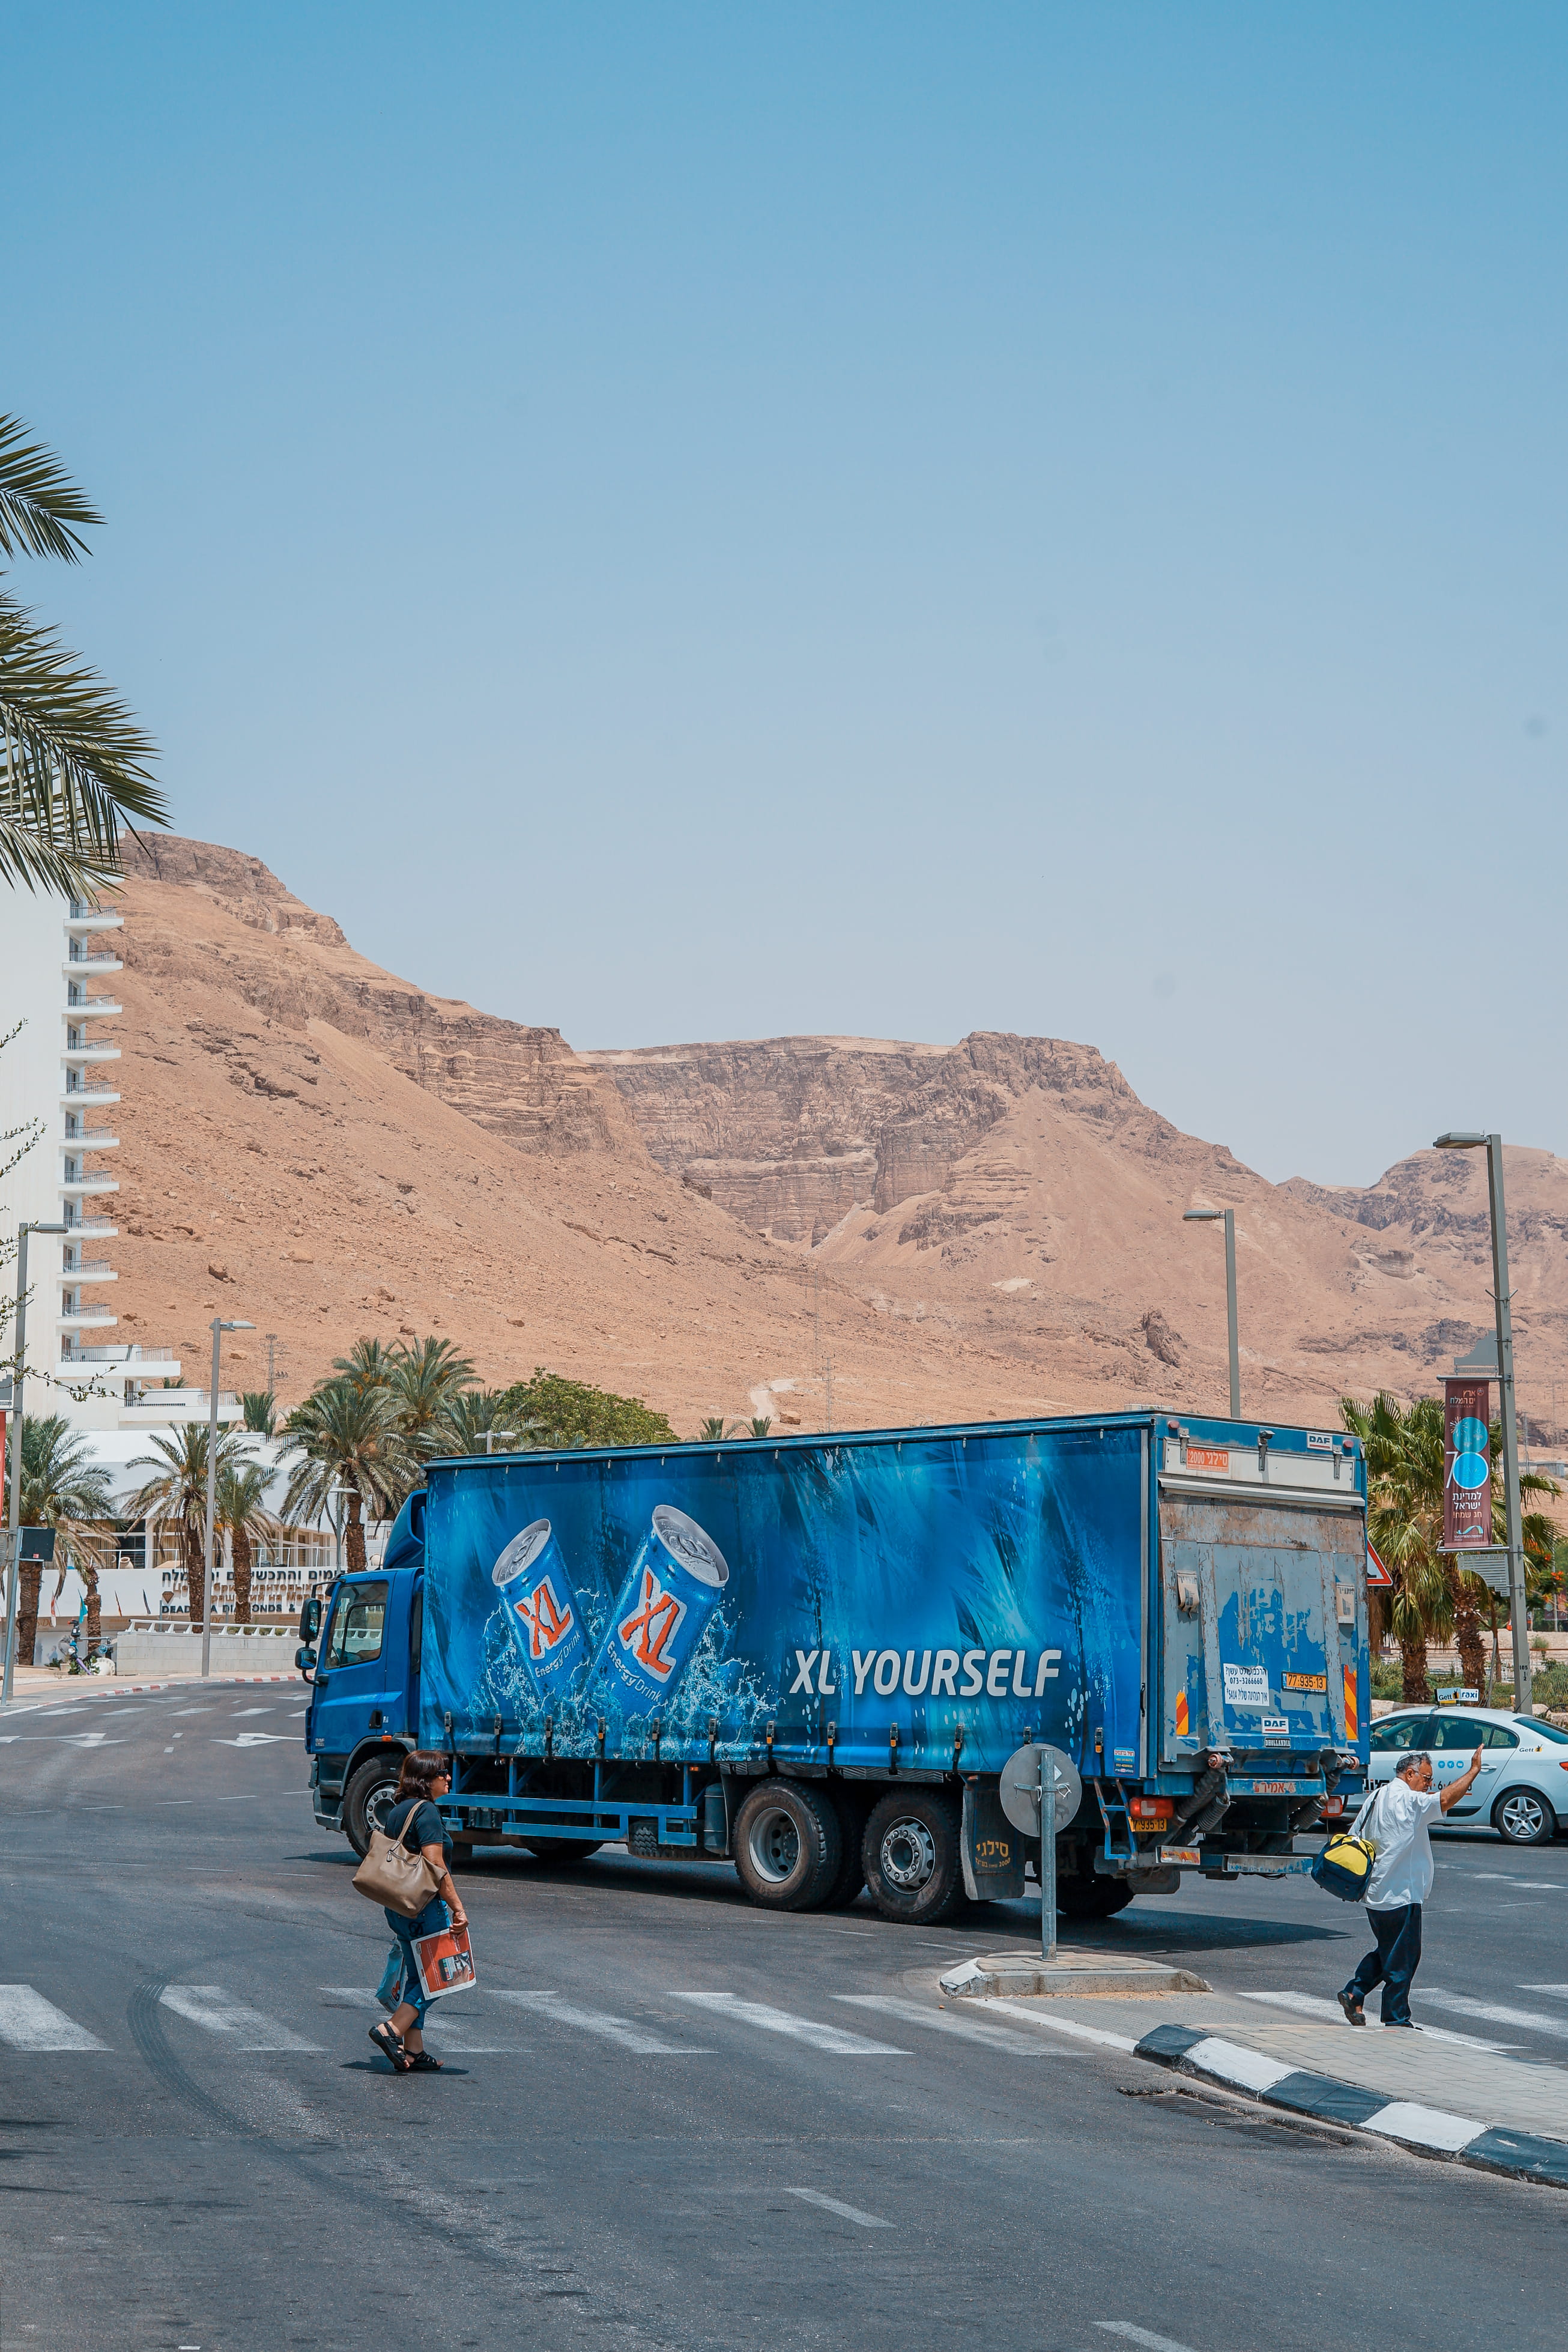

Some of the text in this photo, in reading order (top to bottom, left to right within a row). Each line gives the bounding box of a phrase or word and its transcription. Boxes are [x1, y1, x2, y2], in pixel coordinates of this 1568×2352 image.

[1309, 1435, 1330, 1444] DAF
[1190, 1450, 1205, 1464] 2000
[1206, 1451, 1227, 1466] סילגי
[1452, 1491, 1482, 1501] למדינת
[1454, 1502, 1481, 1510] ישראל
[162, 1604, 190, 1613] DEAD
[289, 1604, 295, 1613] &
[516, 1582, 571, 1656] XL
[620, 1570, 681, 1675] XL
[534, 1629, 581, 1678] Energy Drink
[607, 1640, 662, 1702] Energy Drink
[789, 1649, 1062, 1697] XL YOURSELF
[976, 1840, 1009, 1857] סילגי
[999, 1857, 1011, 1867] 2000
